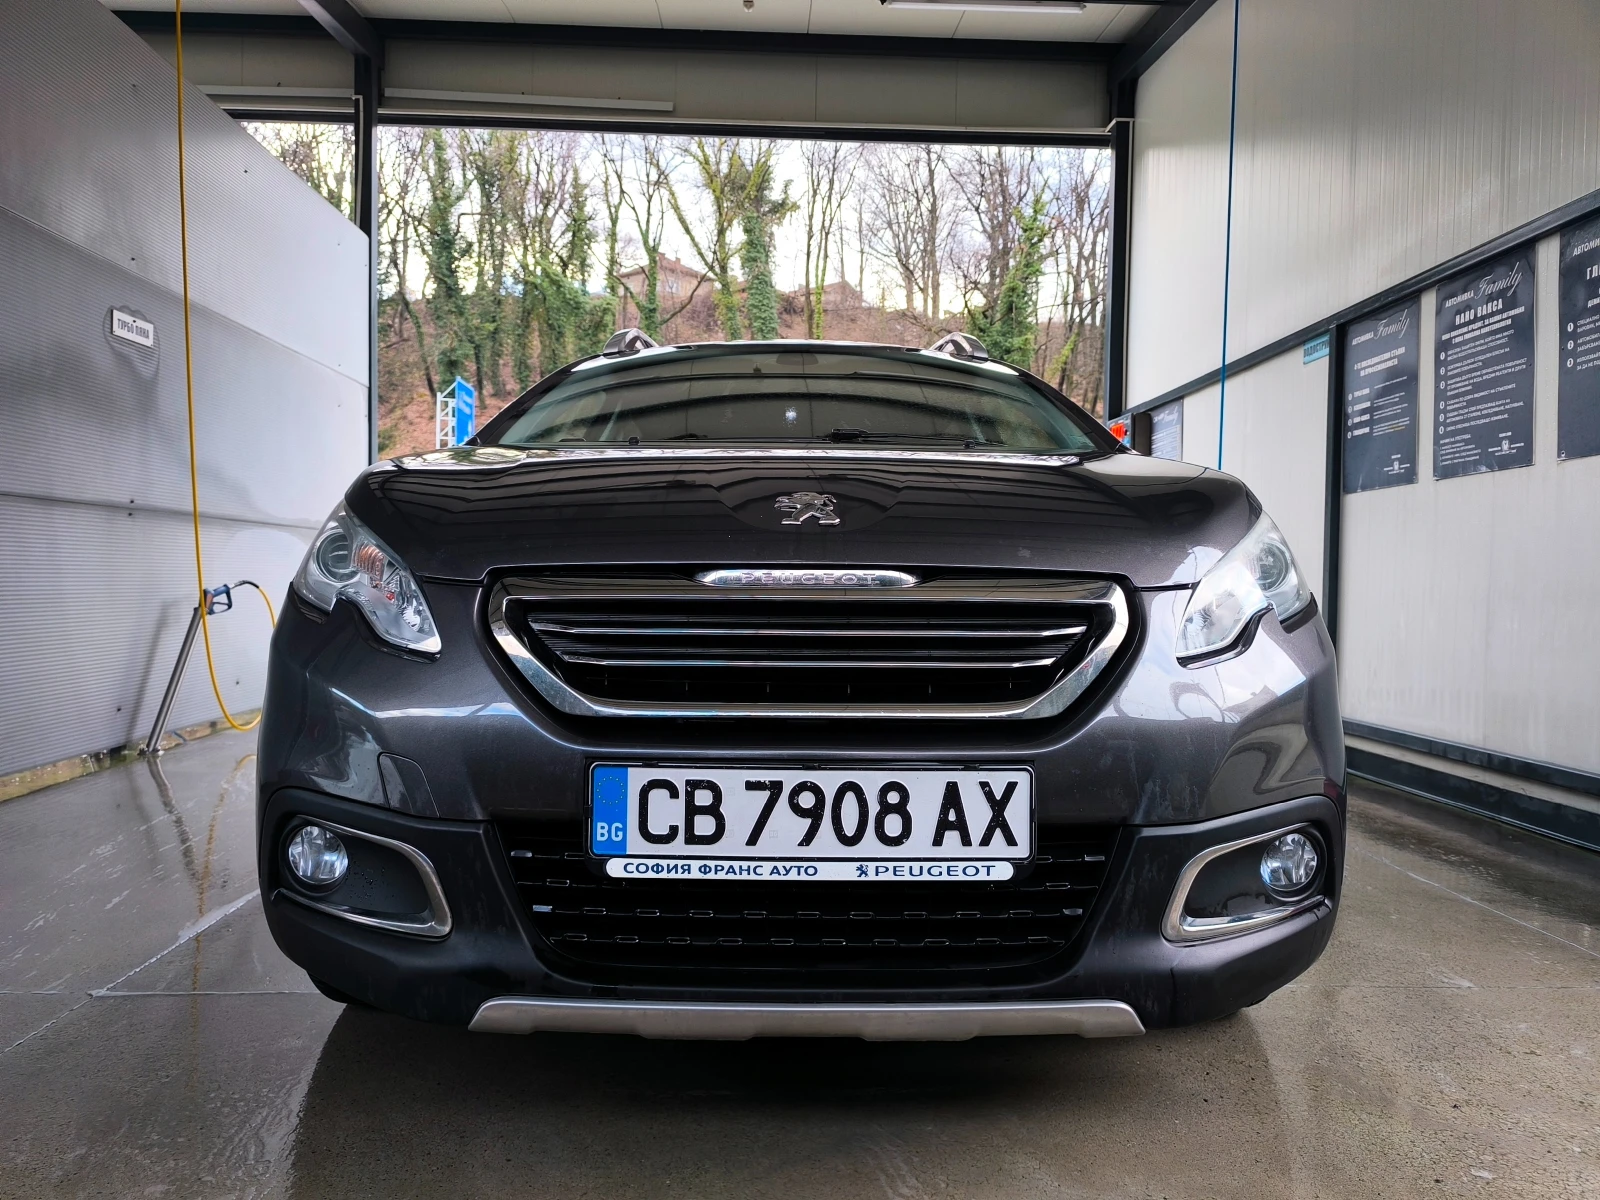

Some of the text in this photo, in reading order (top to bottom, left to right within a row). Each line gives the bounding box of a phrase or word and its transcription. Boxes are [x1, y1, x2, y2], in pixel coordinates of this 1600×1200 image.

[1445, 262, 1522, 308] АВТОМИВКА Family
[1455, 298, 1503, 325] НАНО ВАКСА
[117, 318, 135, 334] ТУРБО
[1374, 308, 1410, 339] Family
[741, 572, 877, 585] PEUGEOT
[638, 778, 1019, 848] CB 7908 AX
[596, 822, 623, 841] BG
[623, 862, 818, 877] СОФИЯ ФРАНС АУТО
[874, 865, 996, 877] PEUGEOT
